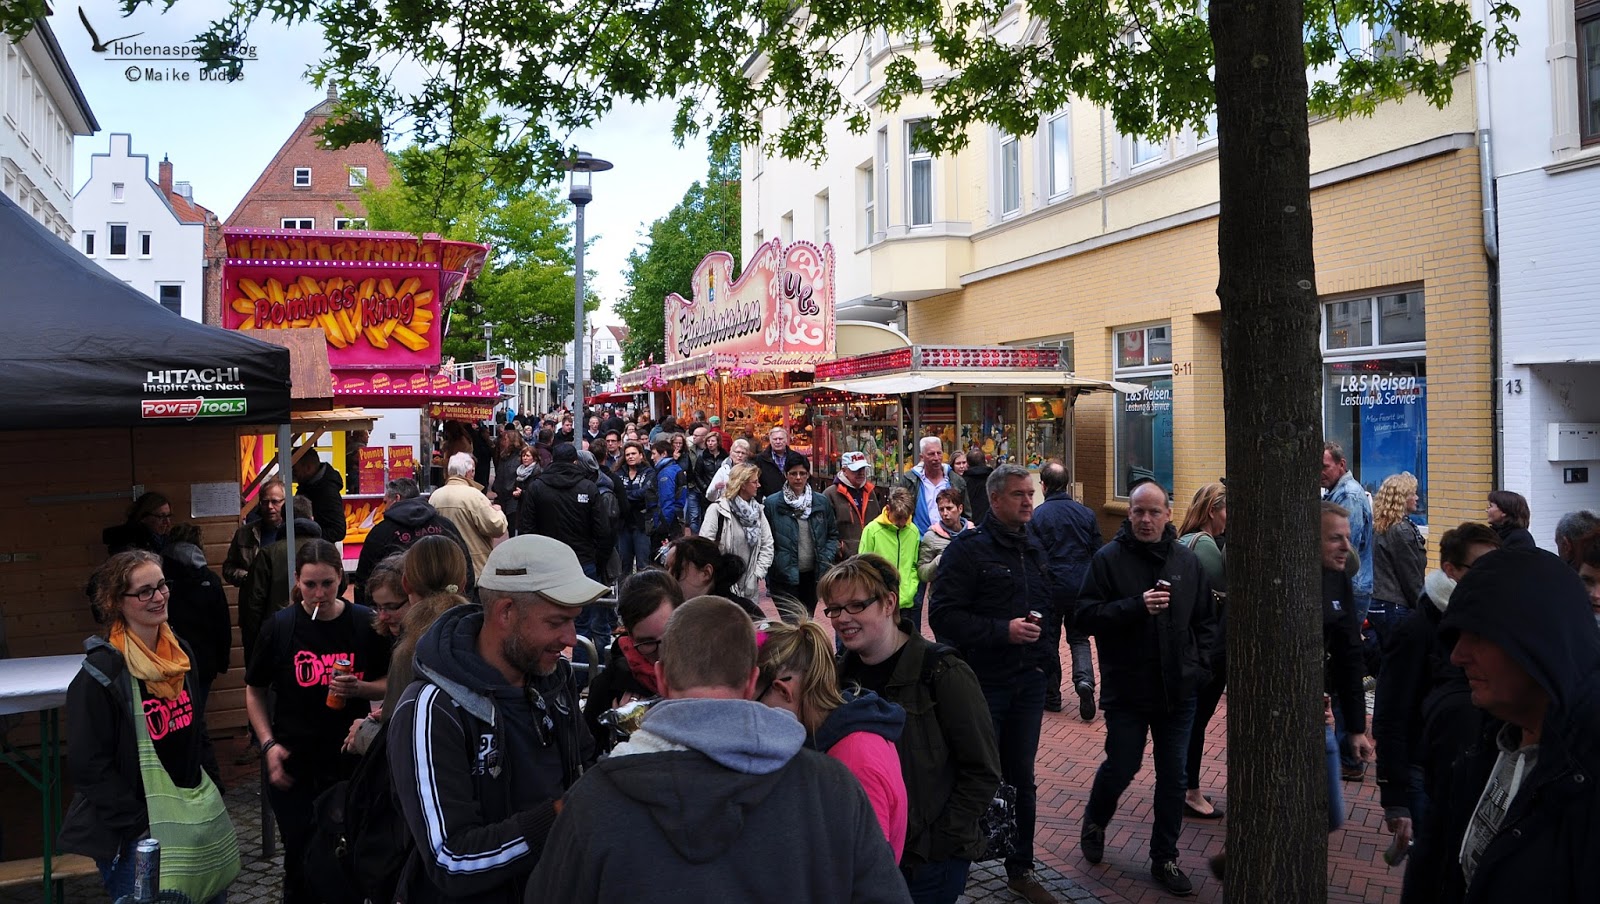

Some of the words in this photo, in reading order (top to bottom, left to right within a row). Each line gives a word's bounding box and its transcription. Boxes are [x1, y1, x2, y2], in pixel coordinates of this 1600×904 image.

[254, 285, 356, 329] Pommes
[361, 292, 415, 328] King
[762, 355, 803, 366] Salmiak
[147, 367, 240, 384] HITACHI
[143, 383, 188, 394] Inspire
[191, 383, 212, 391] the
[215, 383, 245, 391] Next
[1340, 375, 1368, 393] L&S
[1371, 372, 1416, 391] Reisen
[1505, 379, 1522, 394] 13
[1143, 386, 1170, 401] Reisen
[1125, 402, 1147, 413] Leistung
[1151, 400, 1170, 411] Service
[1340, 393, 1375, 409] Leistung
[1376, 393, 1383, 405] &
[1384, 392, 1416, 405] Service
[143, 403, 198, 415] POWER
[203, 402, 245, 413] TOOLS
[442, 405, 471, 414] Pommes
[472, 406, 492, 415] Frites
[359, 448, 384, 460] Pommes
[388, 446, 412, 458] Pommes
